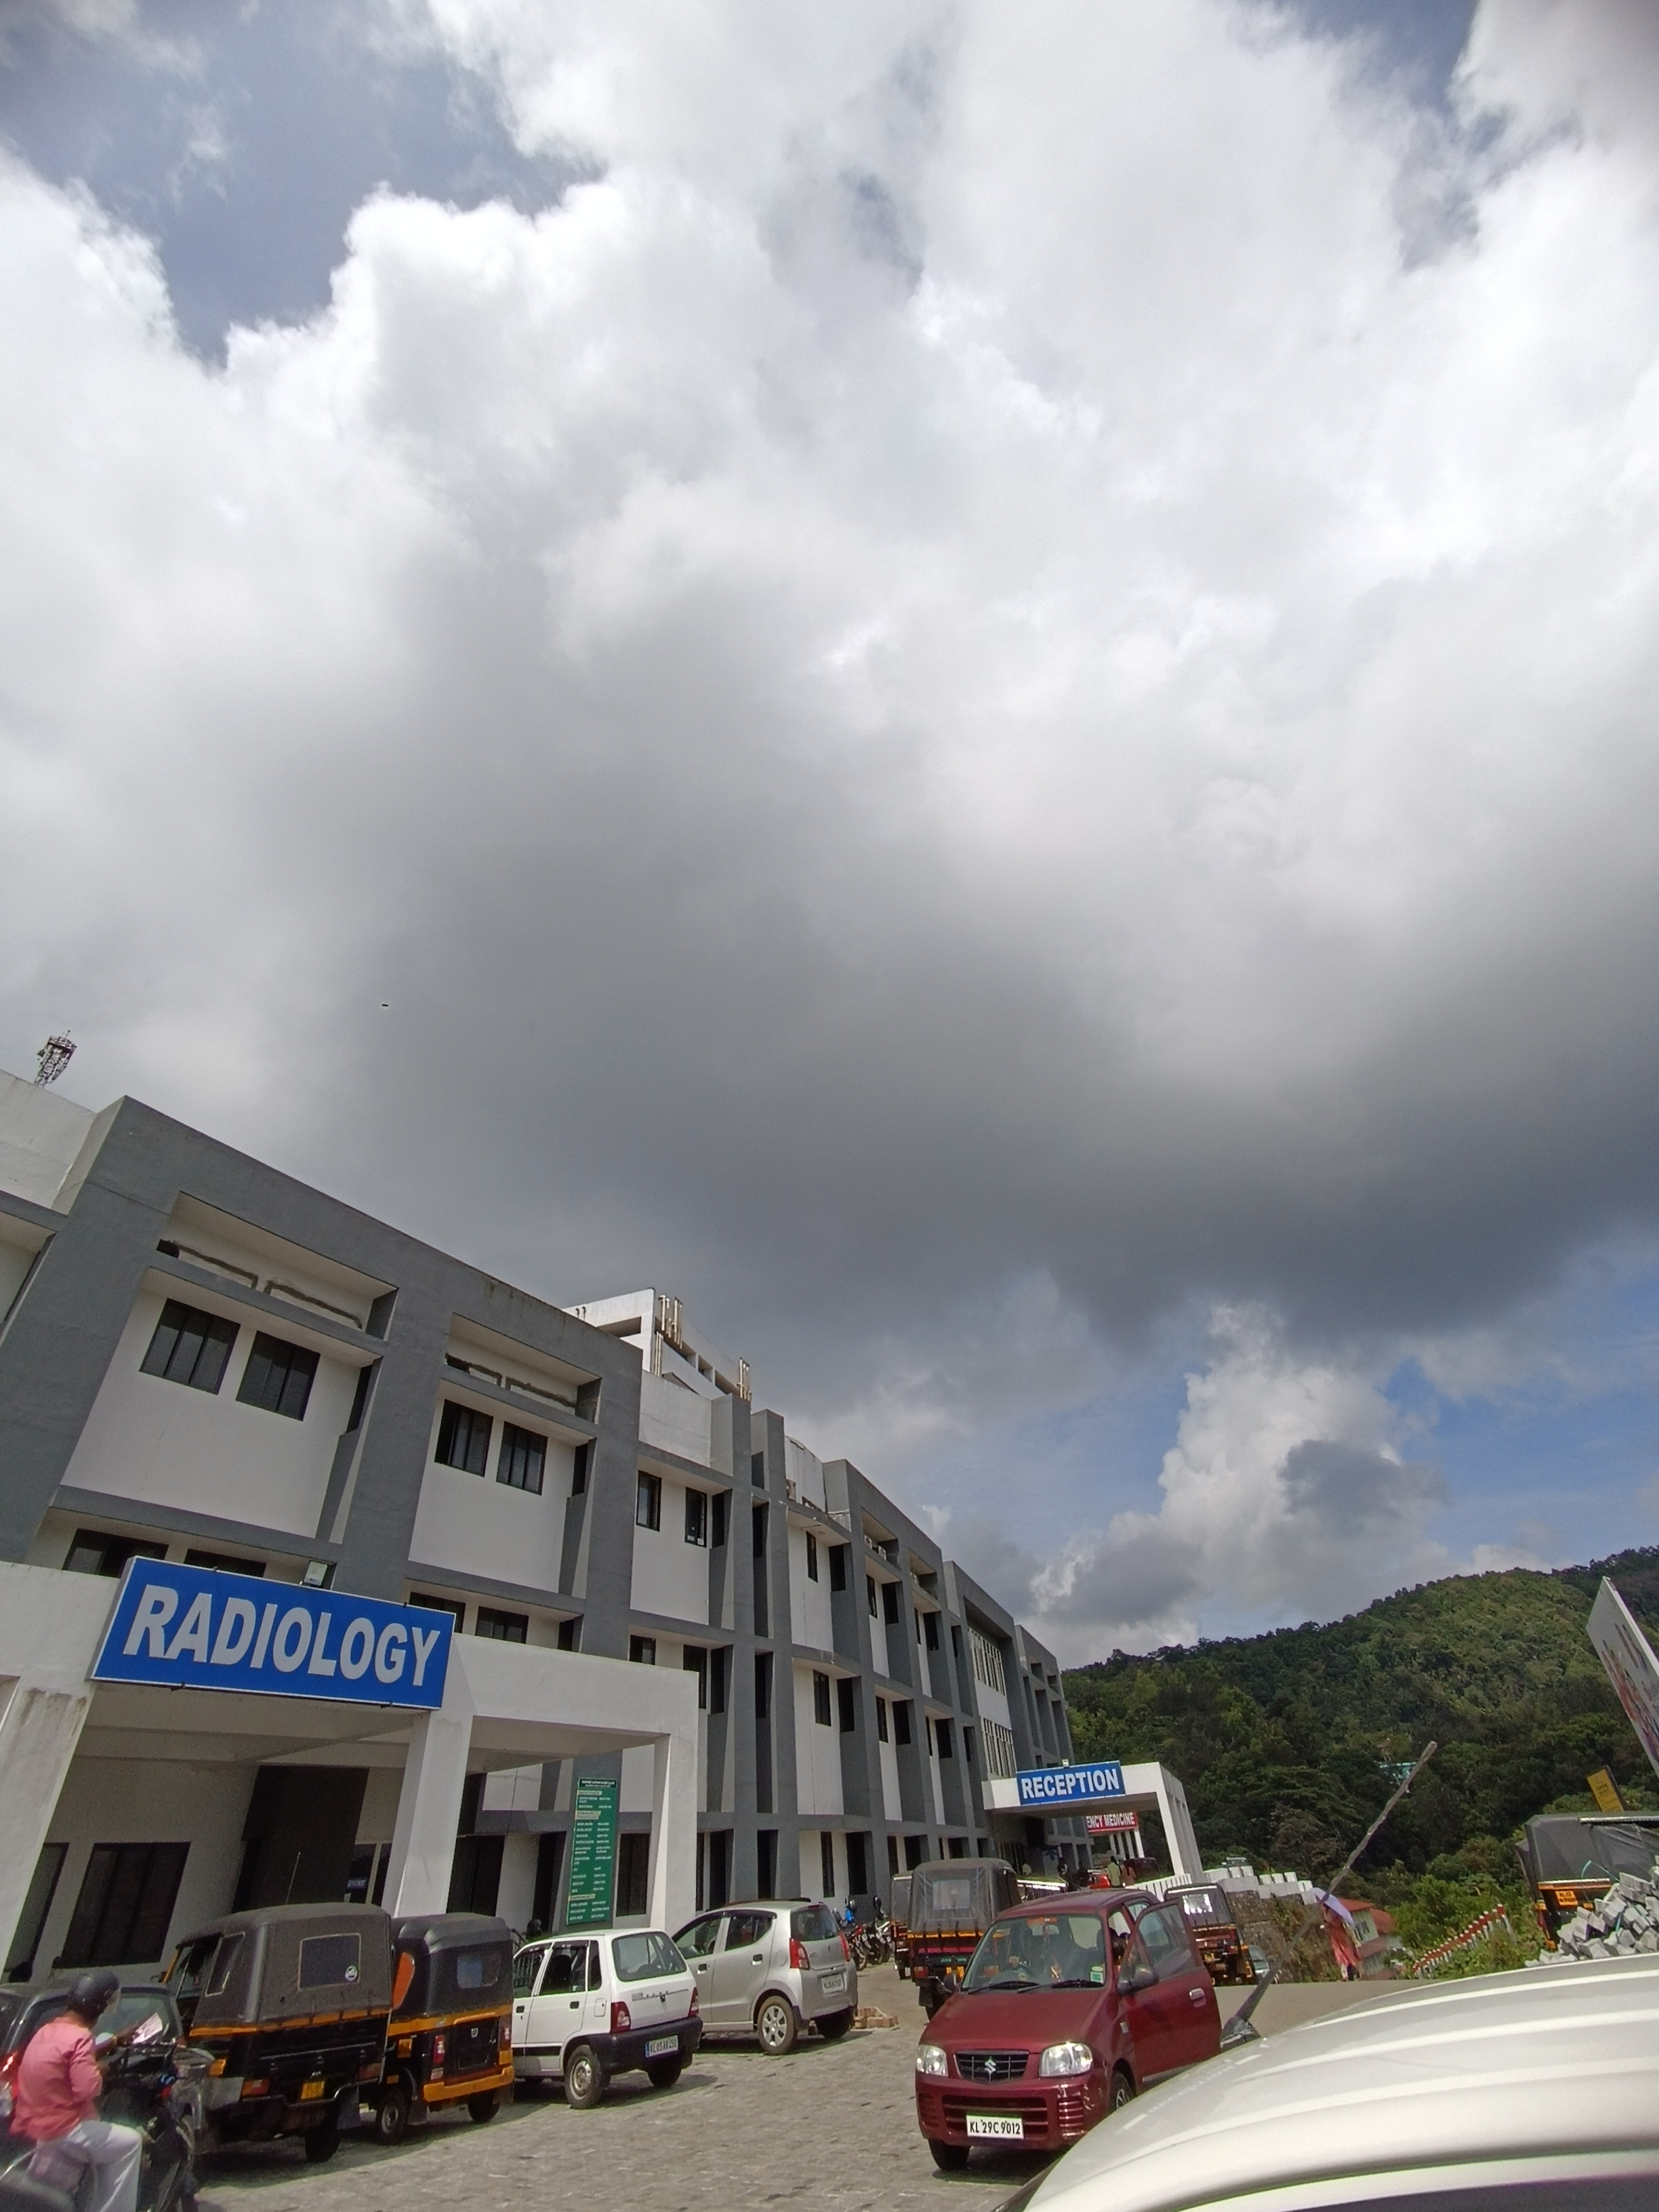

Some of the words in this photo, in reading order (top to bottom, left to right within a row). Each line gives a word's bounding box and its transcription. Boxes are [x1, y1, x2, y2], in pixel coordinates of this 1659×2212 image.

[123, 1584, 441, 1687] RADIOLOGY
[1021, 1768, 1120, 1799] RECEPTION
[1103, 1811, 1135, 1827] MEDICINE
[970, 2121, 980, 2133] KL
[982, 2121, 1000, 2134] 29C
[1000, 2121, 1021, 2135] 9012
